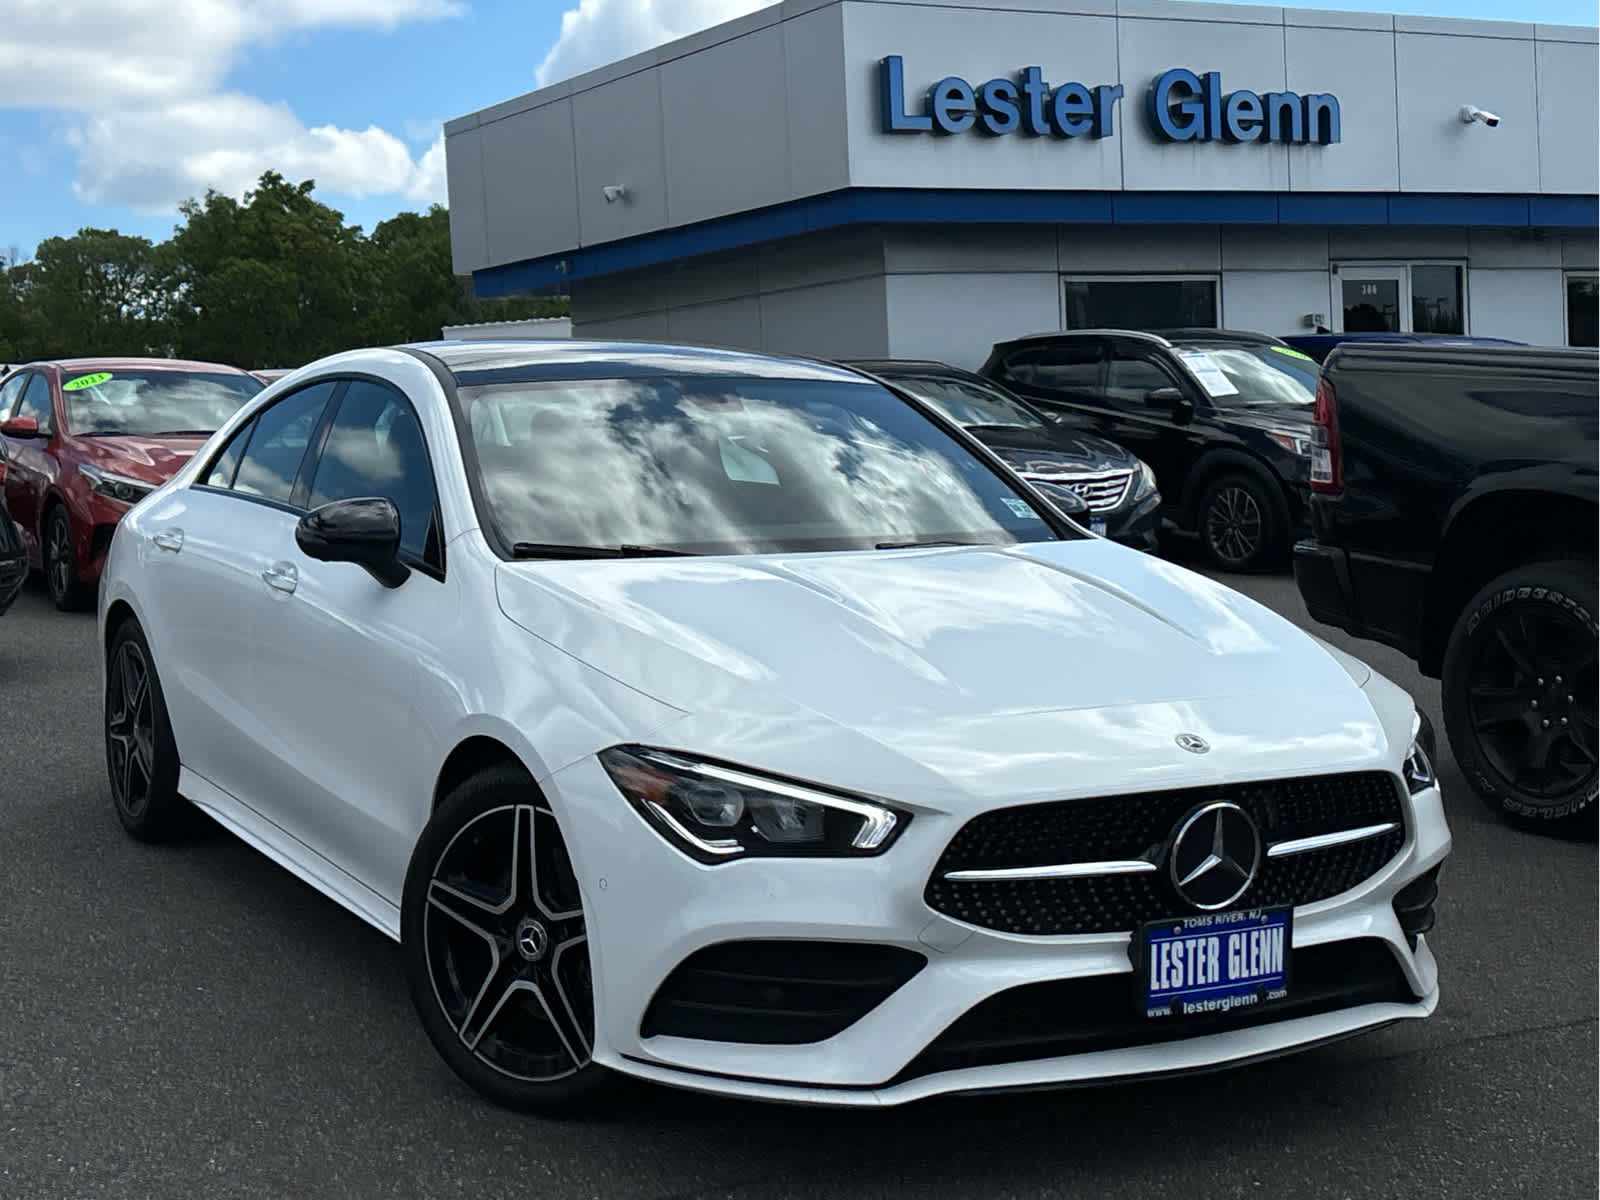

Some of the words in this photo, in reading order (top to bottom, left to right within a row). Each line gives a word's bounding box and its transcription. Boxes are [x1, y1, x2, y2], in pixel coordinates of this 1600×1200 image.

[880, 55, 1123, 138] Lester
[1150, 68, 1341, 144] Glenn
[1183, 917, 1213, 929] TOMS
[1151, 937, 1219, 990] LESTER
[1228, 927, 1284, 980] GLENN
[1183, 993, 1258, 1014] lesterglenn
